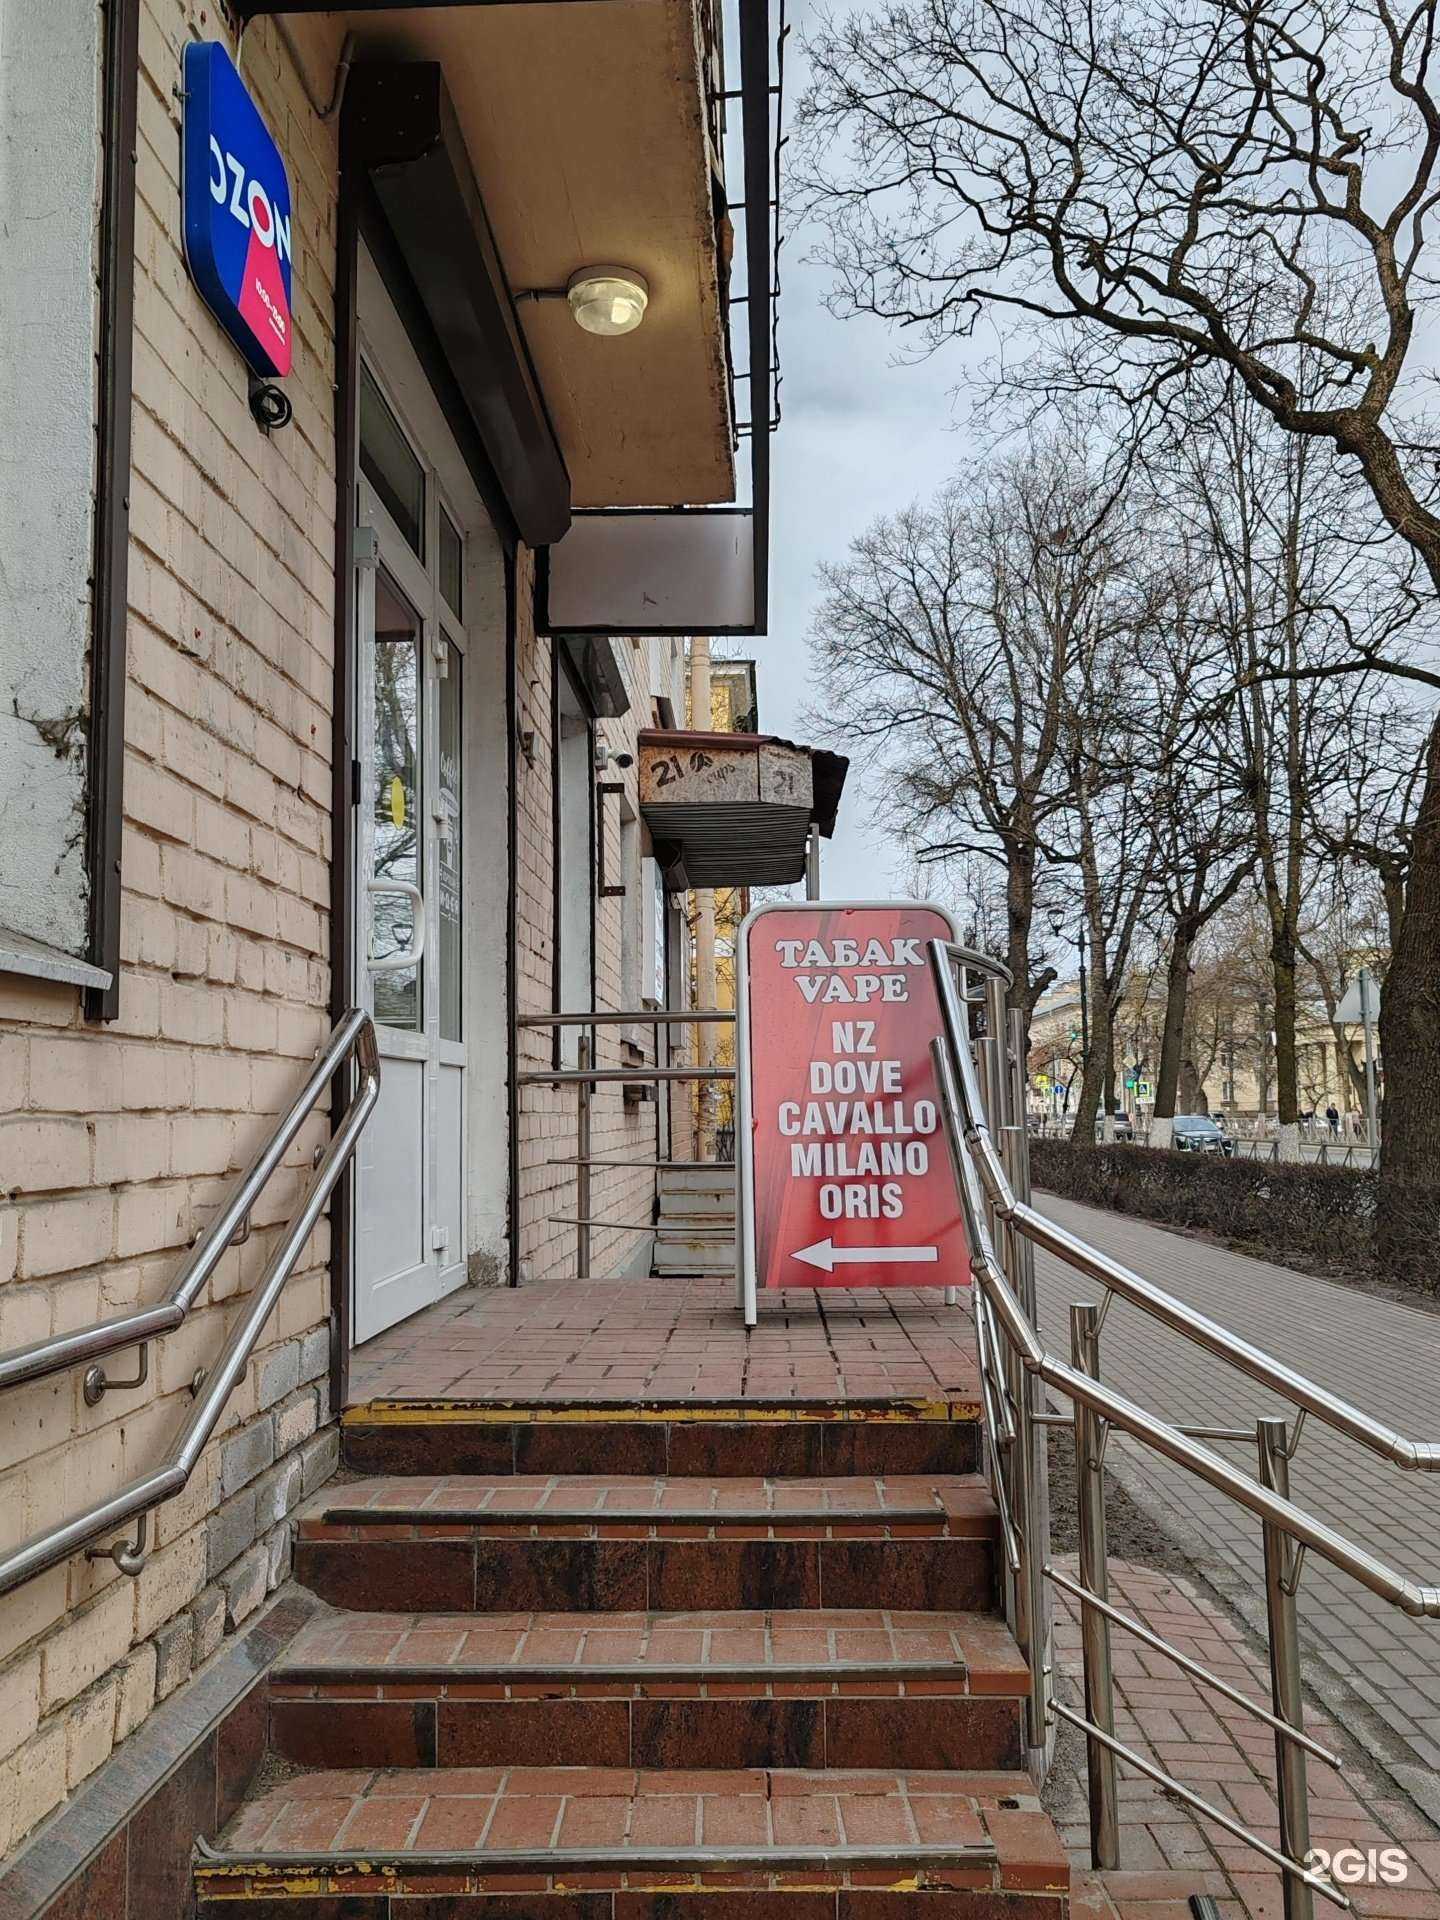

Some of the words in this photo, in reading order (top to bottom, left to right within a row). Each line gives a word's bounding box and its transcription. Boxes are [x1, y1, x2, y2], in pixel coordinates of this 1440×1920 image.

[650, 755, 685, 788] 21
[706, 763, 736, 784] cups
[775, 938, 927, 968] ТАБАК
[794, 973, 910, 1003] VAPE
[831, 1020, 877, 1054] NZ
[810, 1060, 902, 1094] DOVE
[778, 1099, 936, 1136] CAVALLO
[790, 1141, 929, 1177] MILANO
[819, 1182, 904, 1220] ORIS
